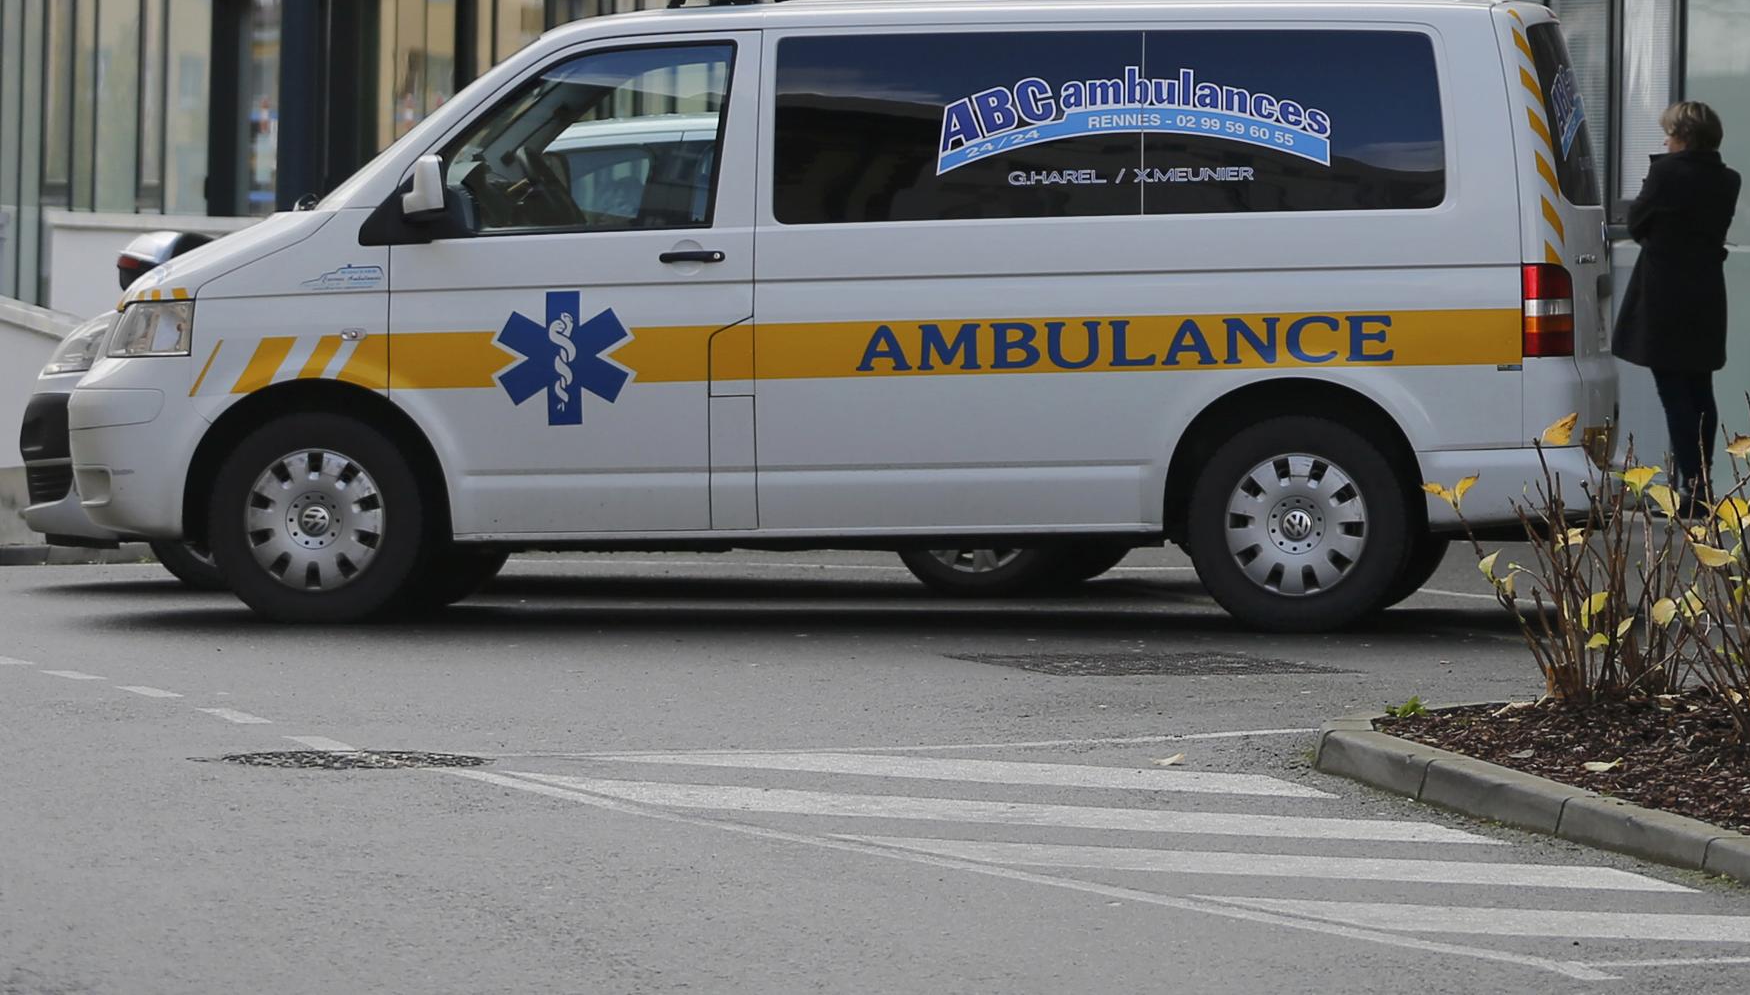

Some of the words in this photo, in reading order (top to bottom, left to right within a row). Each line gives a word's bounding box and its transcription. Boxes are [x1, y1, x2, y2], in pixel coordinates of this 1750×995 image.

[940, 77, 1057, 155] ABC
[1059, 65, 1331, 139] ambulances
[1087, 113, 1161, 130] RENNES
[1176, 115, 1197, 128] 02
[1200, 117, 1221, 131] 99
[1225, 120, 1245, 135] 59
[1249, 125, 1270, 140] 60
[1274, 131, 1295, 146] 55
[855, 314, 1395, 372] AMBULANCE
